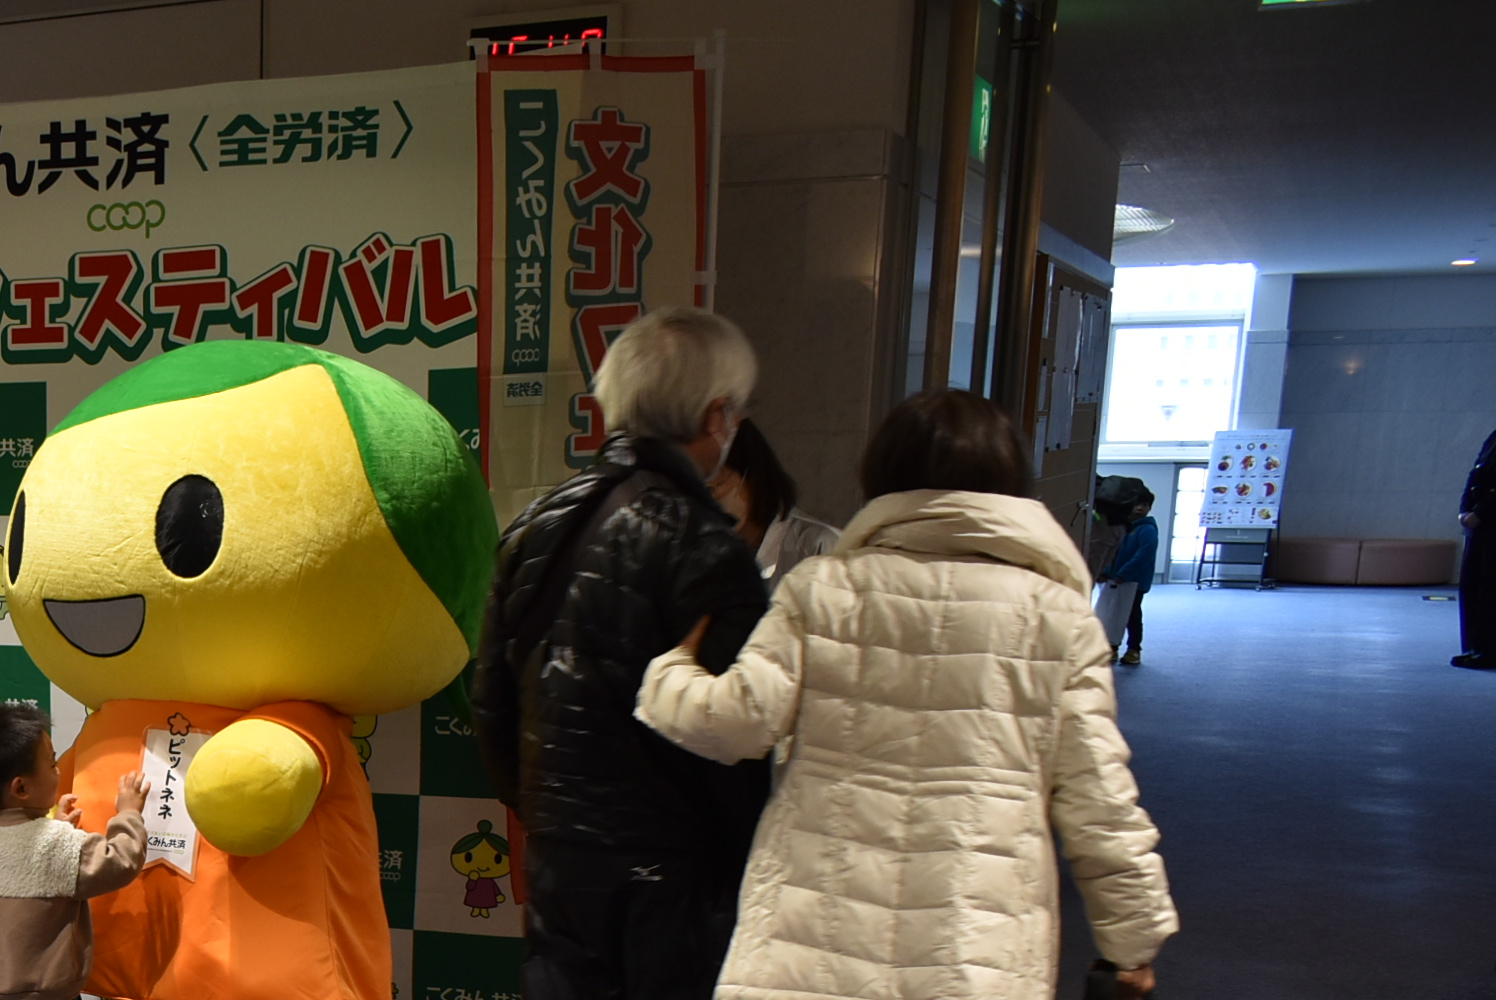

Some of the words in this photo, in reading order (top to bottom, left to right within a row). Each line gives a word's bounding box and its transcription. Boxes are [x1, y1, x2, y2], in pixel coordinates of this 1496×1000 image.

[86, 200, 166, 239] coop
[157, 738, 186, 819] ピットネネ
[147, 837, 186, 849] くみん共済
